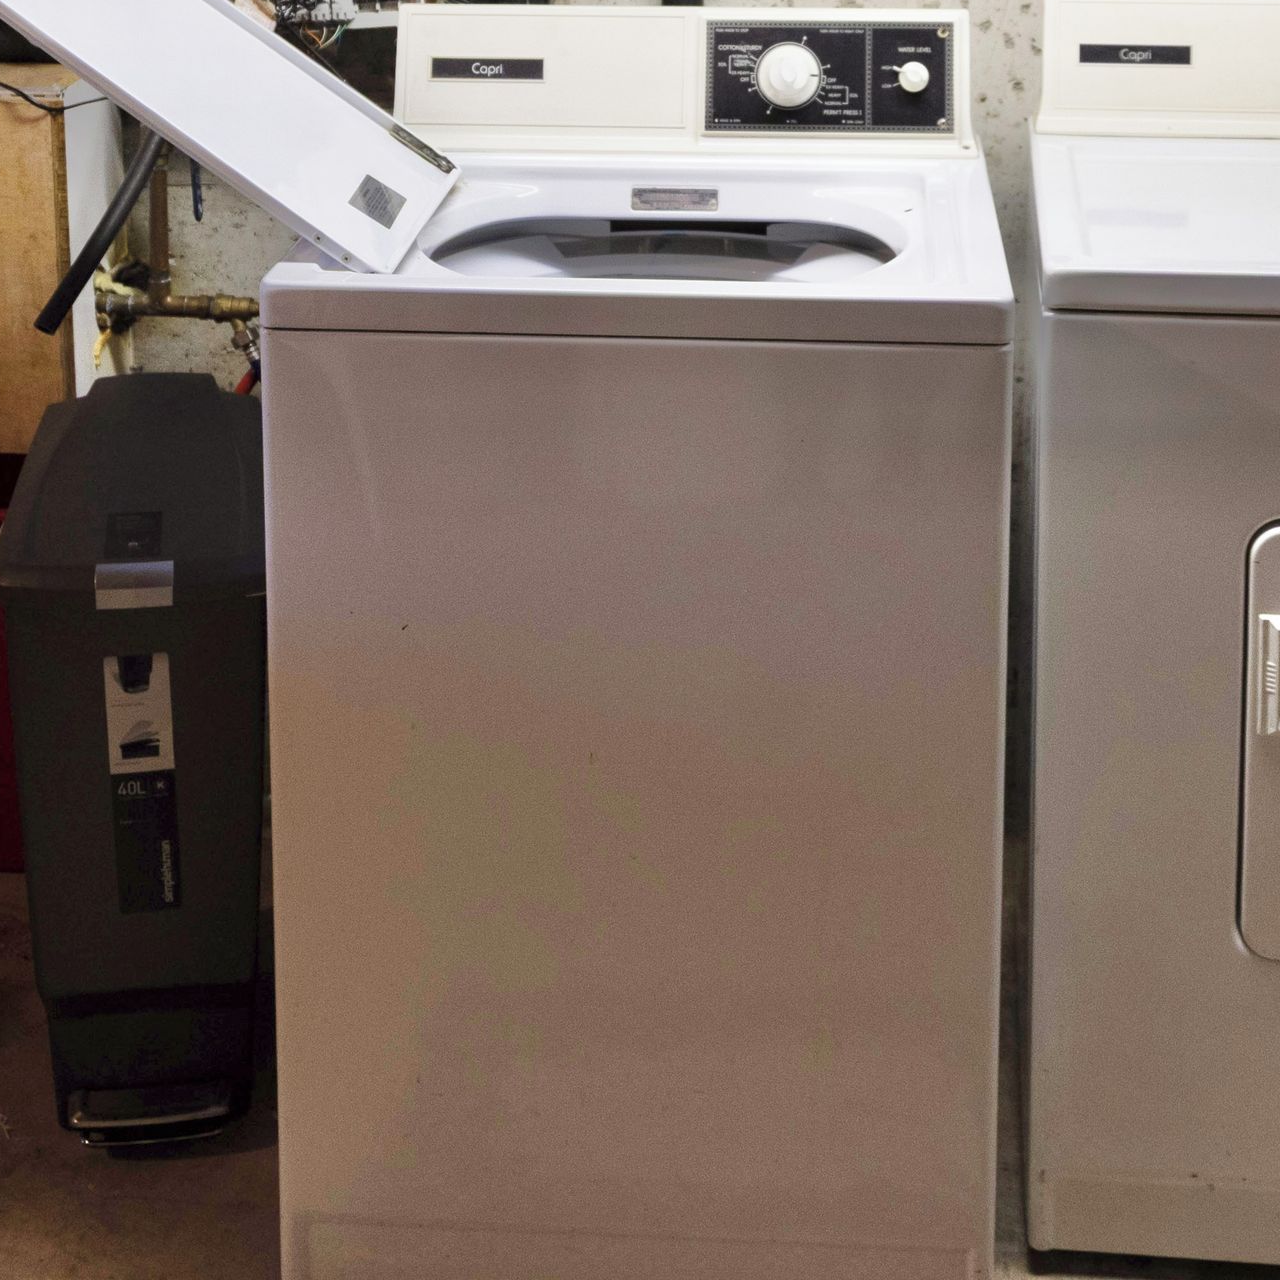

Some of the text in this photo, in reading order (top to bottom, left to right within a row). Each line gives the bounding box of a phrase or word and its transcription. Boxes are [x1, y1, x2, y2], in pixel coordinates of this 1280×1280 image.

[1120, 48, 1152, 62] Capri
[471, 62, 503, 77] Capri
[117, 780, 146, 796] 40L
